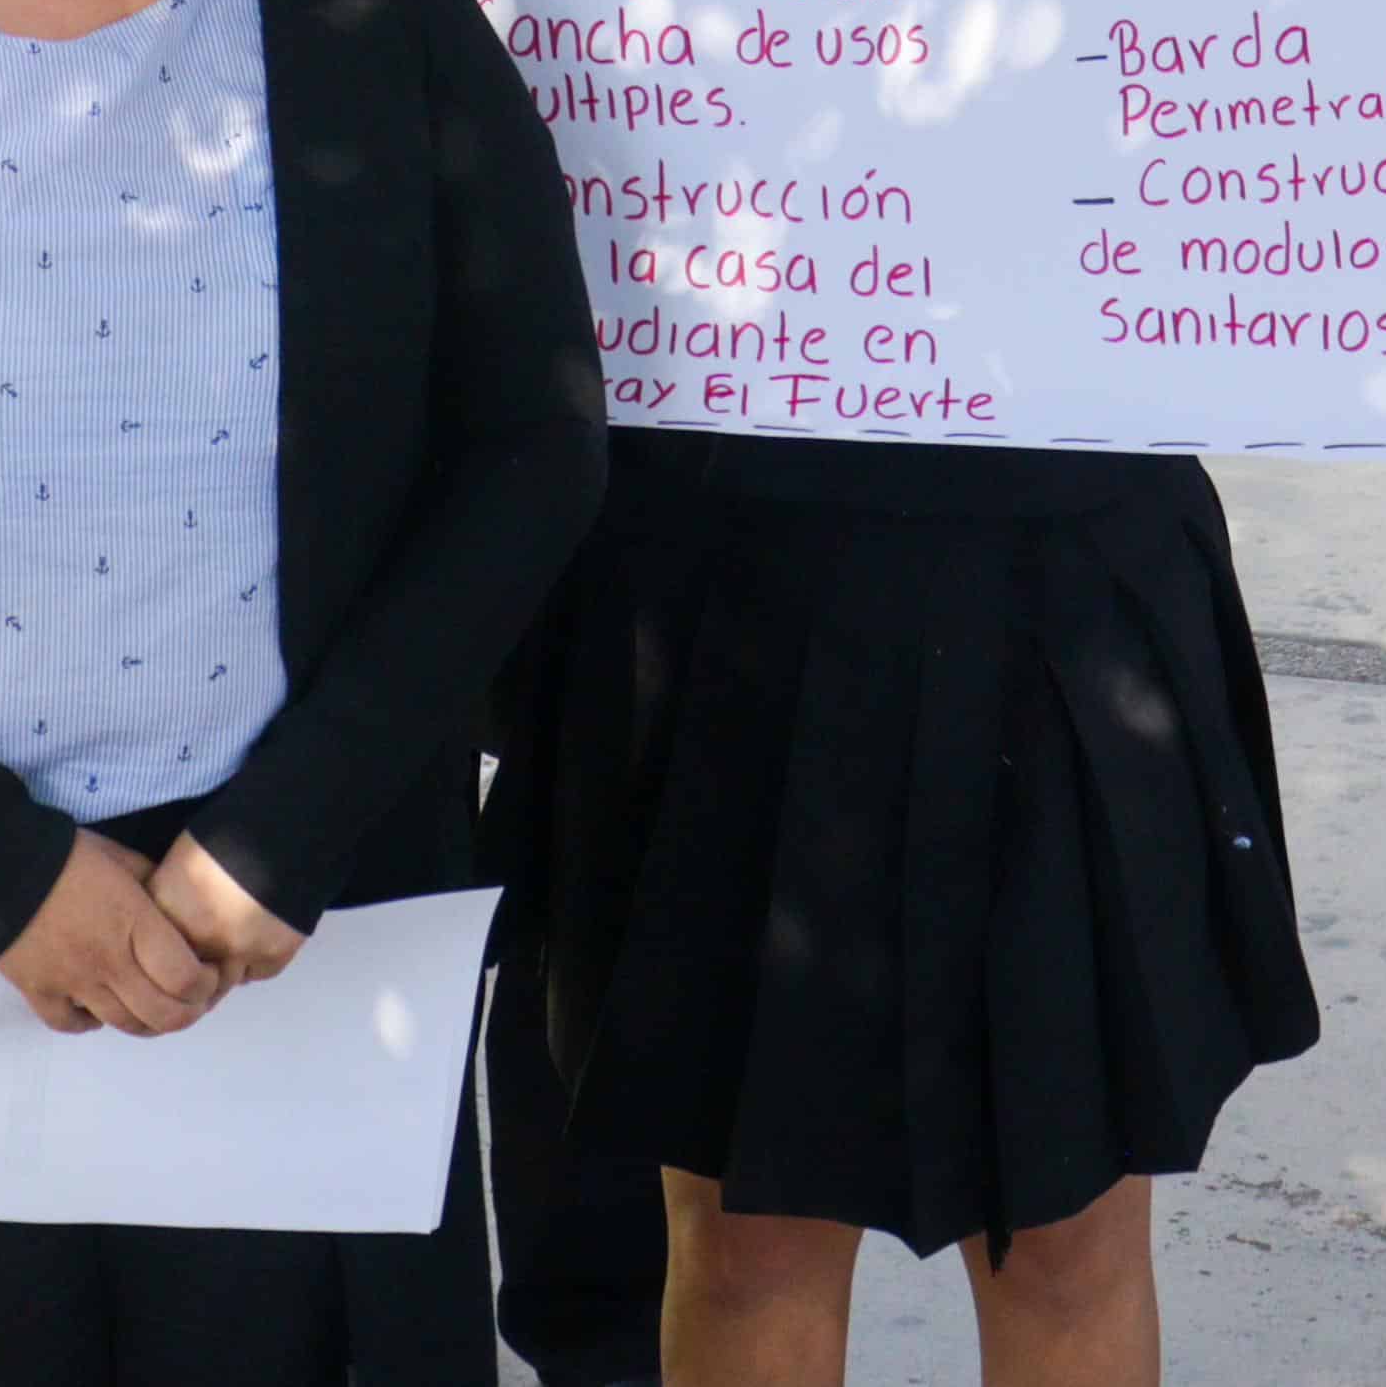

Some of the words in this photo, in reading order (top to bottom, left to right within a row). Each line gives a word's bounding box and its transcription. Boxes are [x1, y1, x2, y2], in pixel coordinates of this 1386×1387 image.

[736, 9, 793, 68] de
[815, 23, 930, 67] usos
[609, 241, 657, 285] la
[685, 245, 817, 295] casa
[850, 245, 932, 298] del
[1080, 228, 1141, 276] de
[864, 323, 937, 365] en
[769, 374, 995, 422] Fuerte
